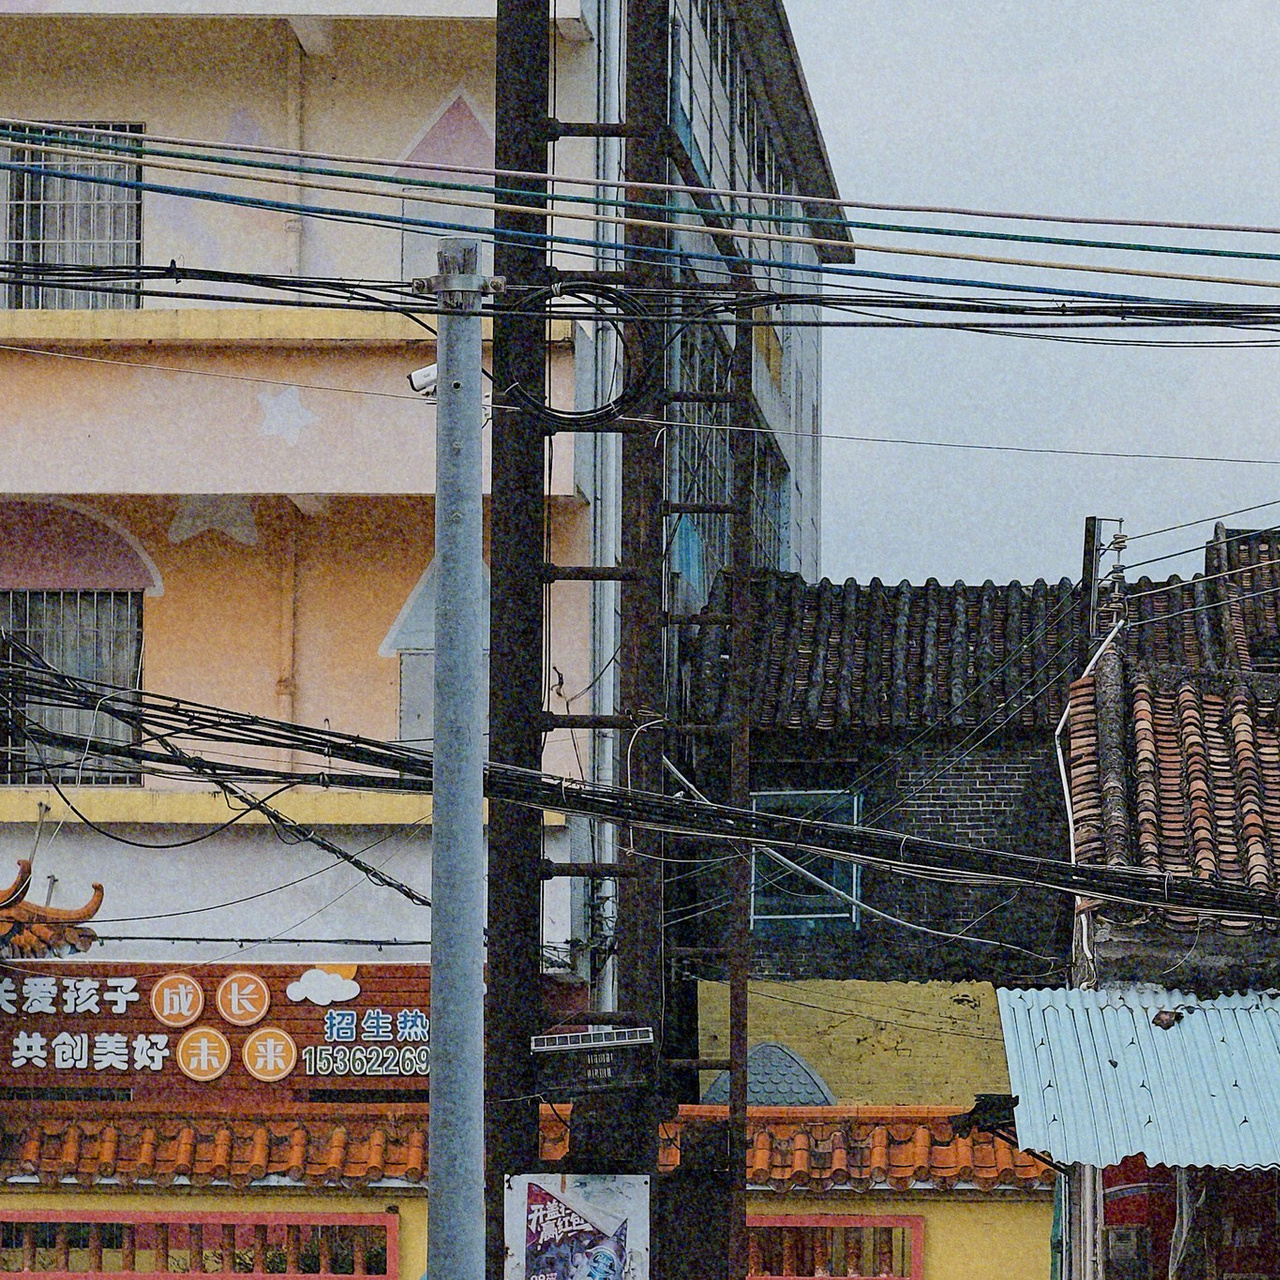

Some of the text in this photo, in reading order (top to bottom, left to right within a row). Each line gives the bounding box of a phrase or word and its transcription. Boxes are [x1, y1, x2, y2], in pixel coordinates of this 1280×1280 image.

[324, 1009, 430, 1042] 招生热
[11, 1031, 287, 1072] 共创美好未来
[302, 1045, 431, 1076] 15362269
